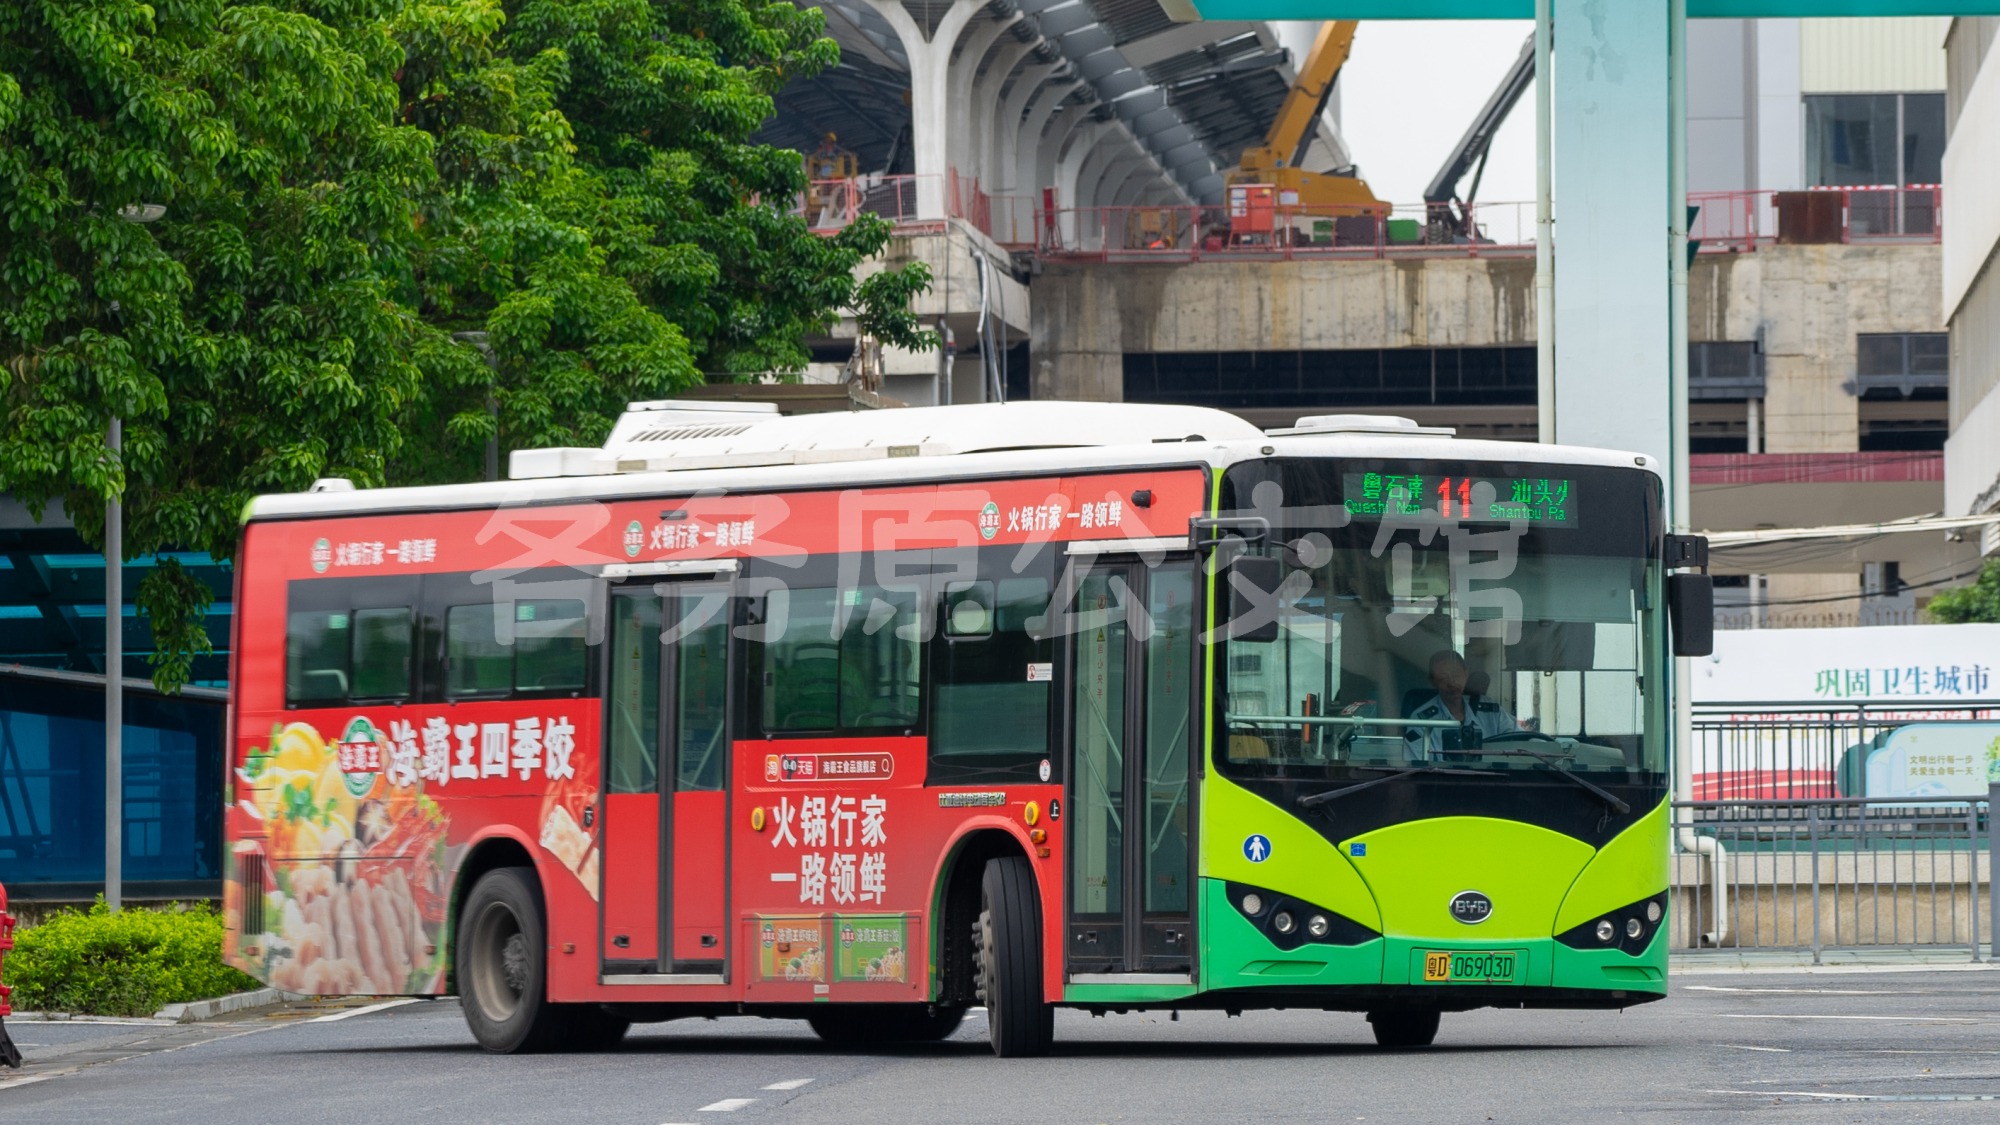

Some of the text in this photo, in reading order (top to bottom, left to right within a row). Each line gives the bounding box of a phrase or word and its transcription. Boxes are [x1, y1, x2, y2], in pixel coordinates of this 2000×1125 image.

[1344, 499, 1420, 515] Queshi Nan
[1437, 477, 1470, 518] 11
[1007, 501, 1122, 533] 火锅行家 一路领鲜
[1489, 504, 1542, 520] Shantou
[649, 523, 700, 551] 火锅行家
[1814, 664, 1991, 698] 巩固卫生城市
[386, 714, 576, 787] 海霸王四季饺
[822, 759, 877, 775] 海霸王食品旗舰店
[771, 794, 887, 848] 火锅行家
[1050, 802, 1059, 817] 上
[770, 852, 887, 906] 一路领鲜
[1454, 900, 1488, 914] BYD
[1428, 957, 1513, 977] 粤D 06903D
